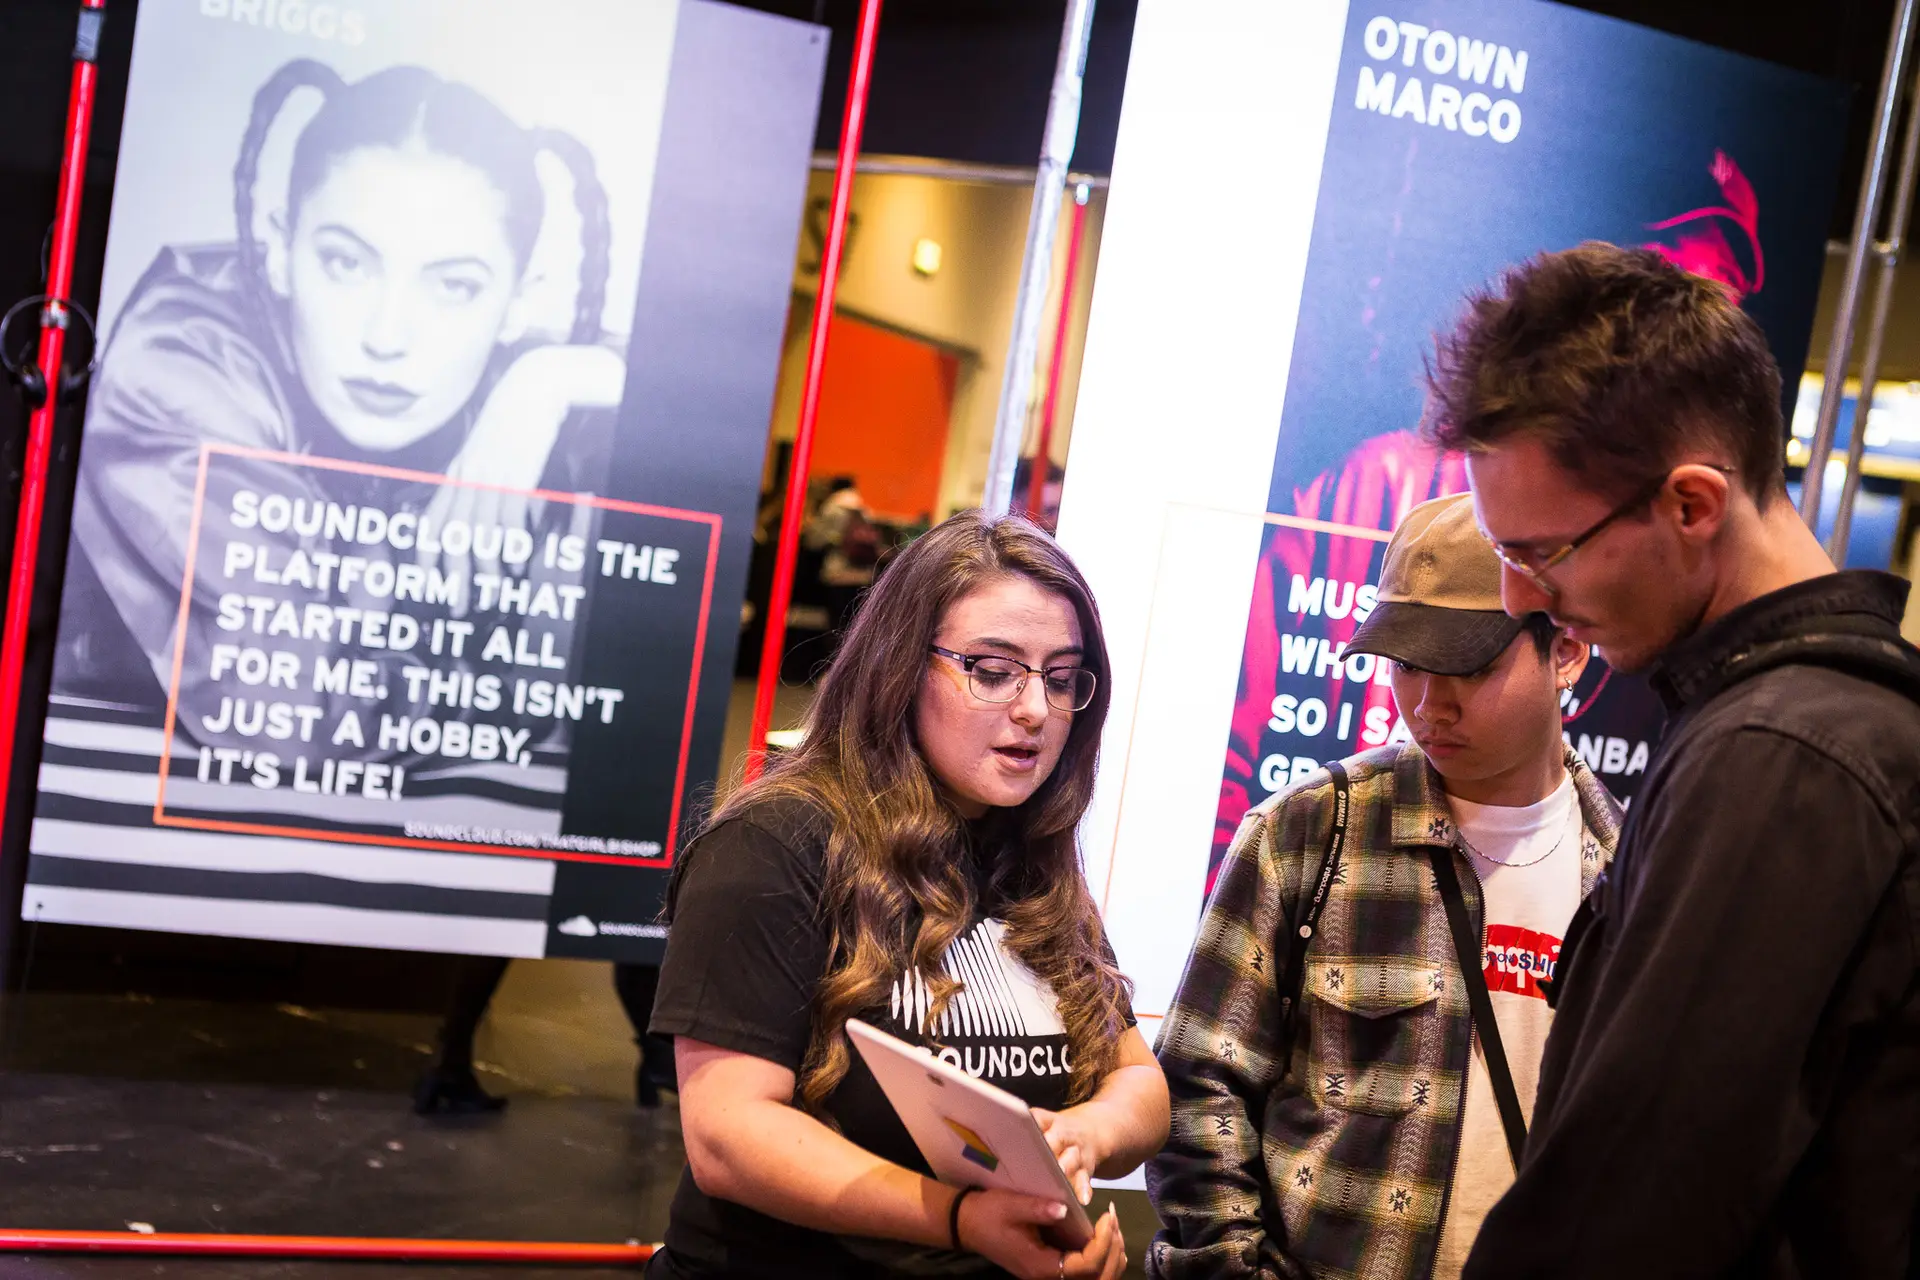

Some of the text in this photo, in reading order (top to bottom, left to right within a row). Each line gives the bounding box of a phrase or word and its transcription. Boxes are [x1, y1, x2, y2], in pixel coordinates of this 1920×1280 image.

[1364, 15, 1529, 93] OTOWN
[1354, 66, 1522, 143] MARCO
[229, 490, 680, 585] SOUNDCLOUD IS THE
[223, 541, 586, 621] PLATFORM THAT
[216, 592, 566, 669] STARTED IT ALL
[209, 643, 624, 724] FOR ME. THIS ISN'T
[1267, 693, 1328, 737] SO
[1336, 702, 1353, 740] I
[201, 696, 532, 769] JUST A HOBBY,
[197, 746, 405, 801] IT'S LIFE!
